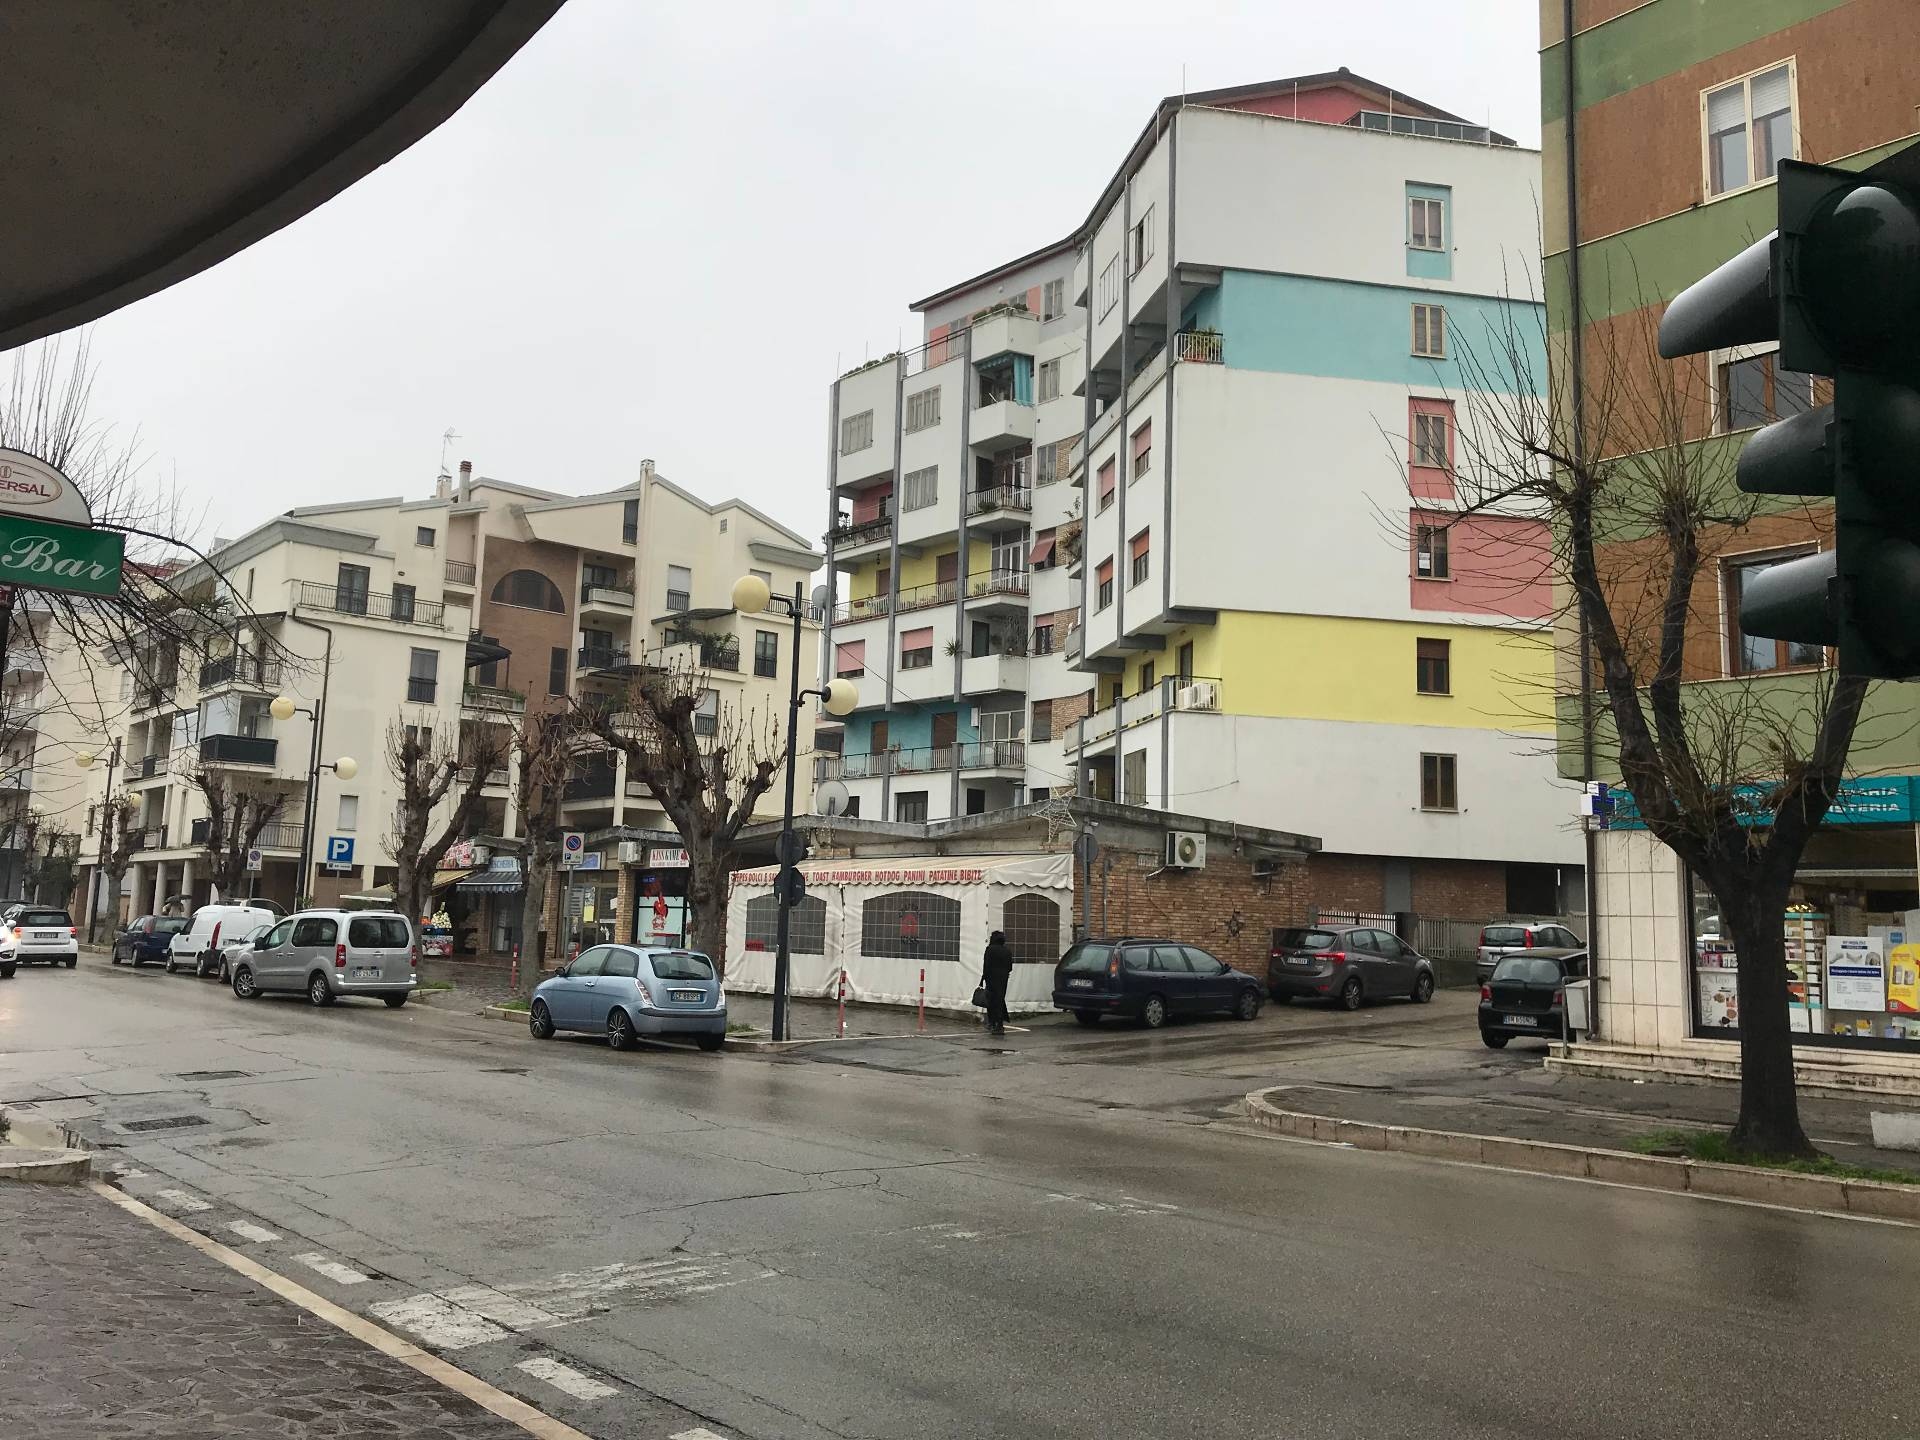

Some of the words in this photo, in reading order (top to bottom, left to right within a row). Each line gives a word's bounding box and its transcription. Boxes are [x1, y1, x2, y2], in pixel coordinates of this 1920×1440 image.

[1, 536, 116, 580] Bar
[332, 839, 349, 860] P
[748, 873, 763, 882] DOLCI
[812, 871, 829, 881] TOAST
[832, 871, 872, 881] HAMBURGHER
[874, 870, 900, 881] HOTDOG
[903, 870, 926, 881] PANINI
[928, 870, 958, 881] PATATINE
[959, 869, 982, 881] BIBITE
